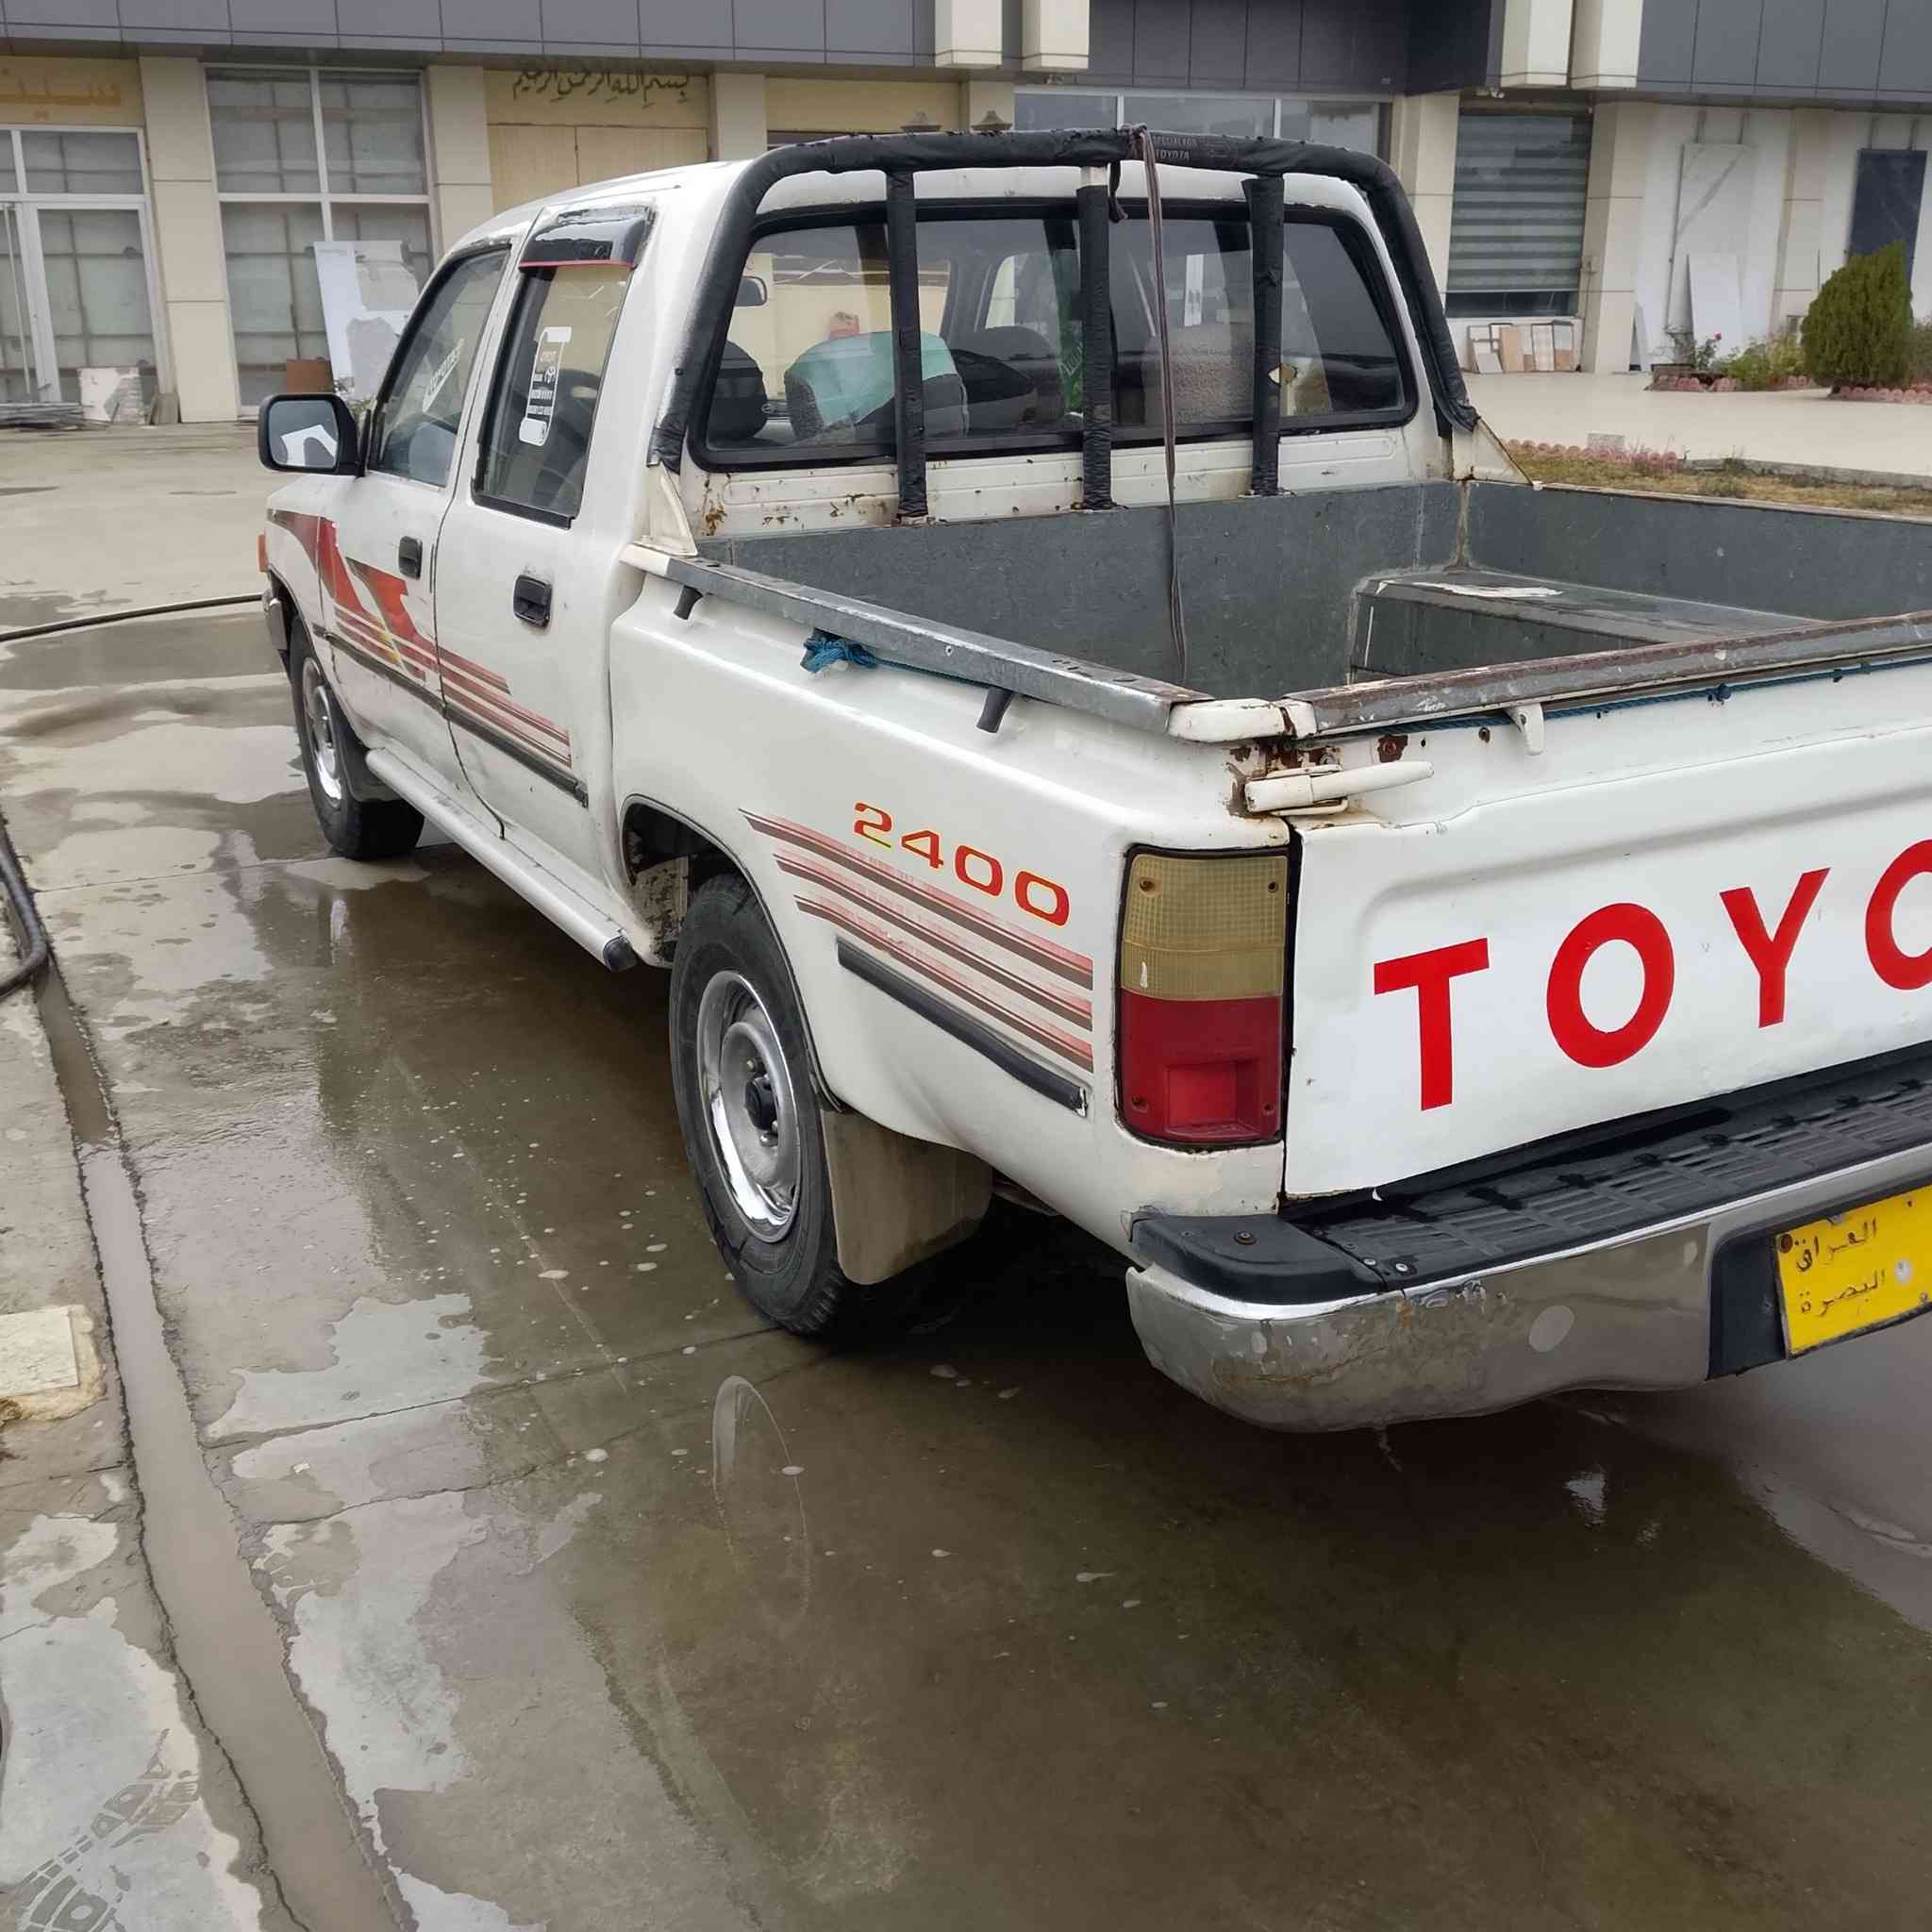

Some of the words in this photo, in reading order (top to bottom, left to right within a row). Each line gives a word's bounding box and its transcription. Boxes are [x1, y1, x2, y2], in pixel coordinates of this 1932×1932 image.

[641, 70, 691, 108] بسم
[1155, 149, 1191, 159] TOYOTA
[853, 802, 1071, 926] 2400
[1795, 1217, 1877, 1273] العراق
[1800, 1268, 1886, 1318] البصرة
